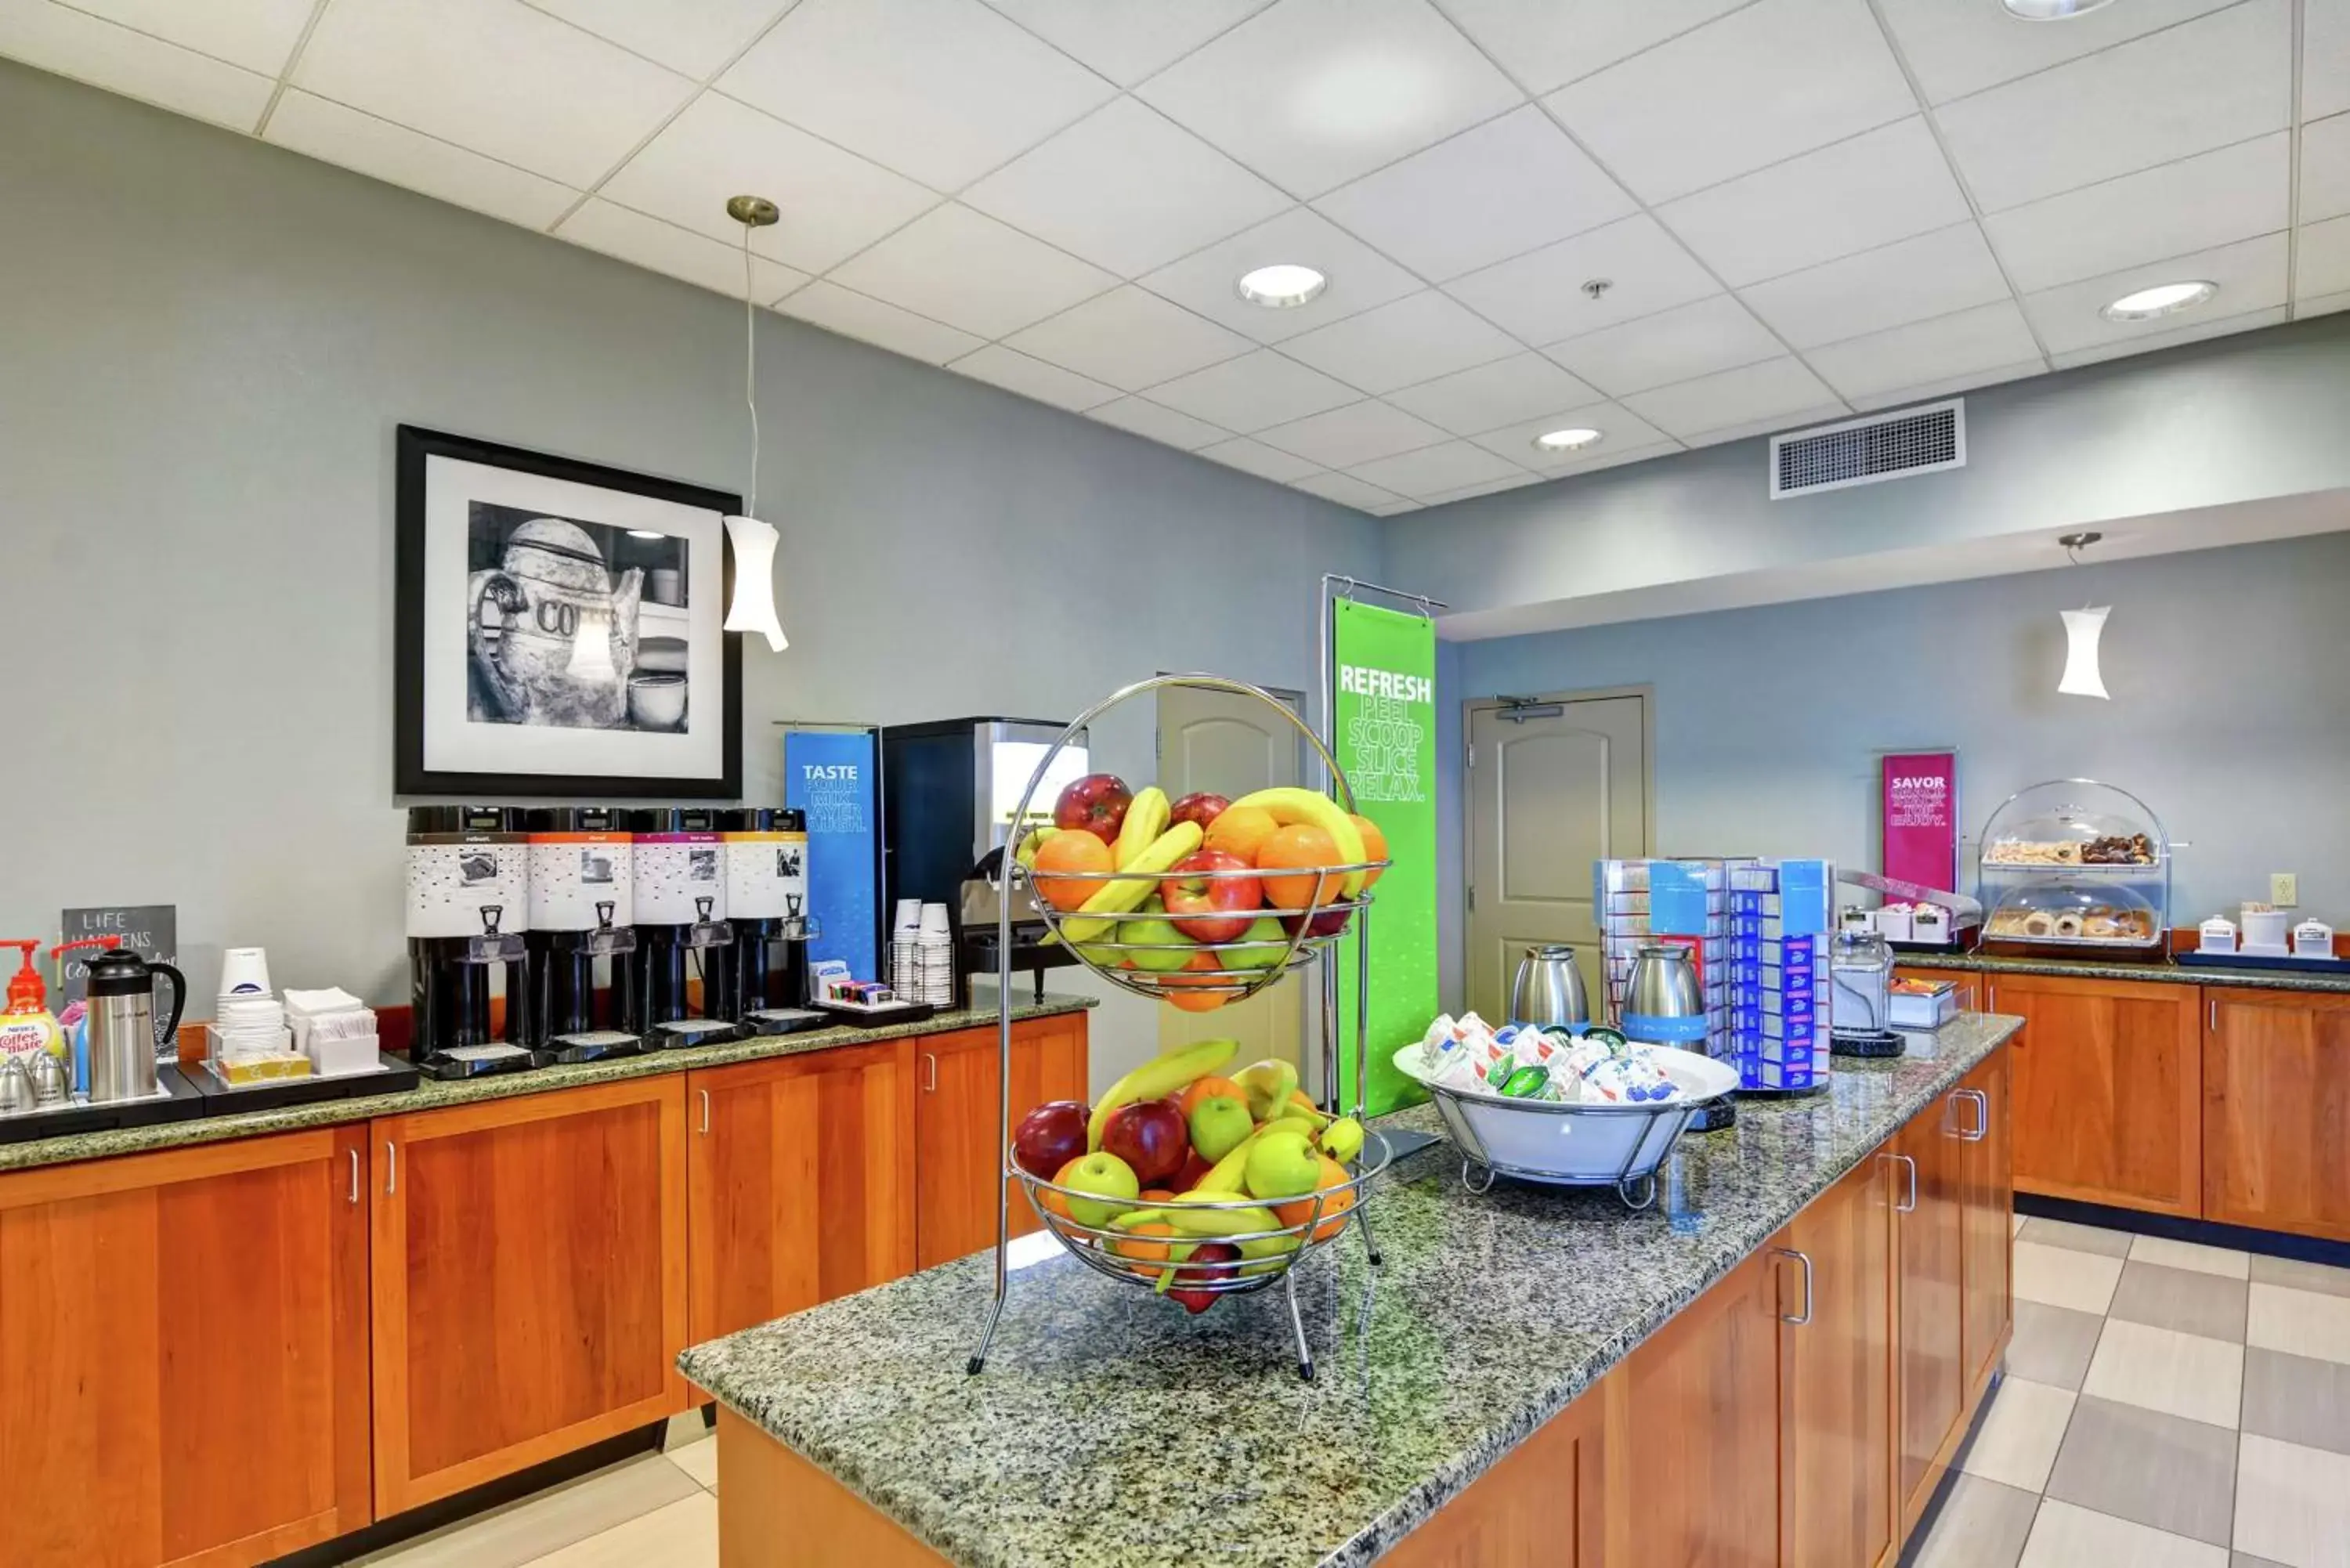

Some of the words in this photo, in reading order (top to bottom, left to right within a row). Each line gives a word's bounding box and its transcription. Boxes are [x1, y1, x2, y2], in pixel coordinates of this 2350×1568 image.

[1340, 664, 1431, 703] REFRESH
[1361, 692, 1413, 722] PEEL
[1348, 717, 1423, 752] SCOOP
[802, 764, 858, 779] TASTE
[1356, 746, 1417, 776] SLICE
[1347, 770, 1426, 802] RELAX.
[1892, 776, 1946, 789] SAVOR
[811, 790, 851, 806] MIX
[83, 912, 127, 930] LIFE
